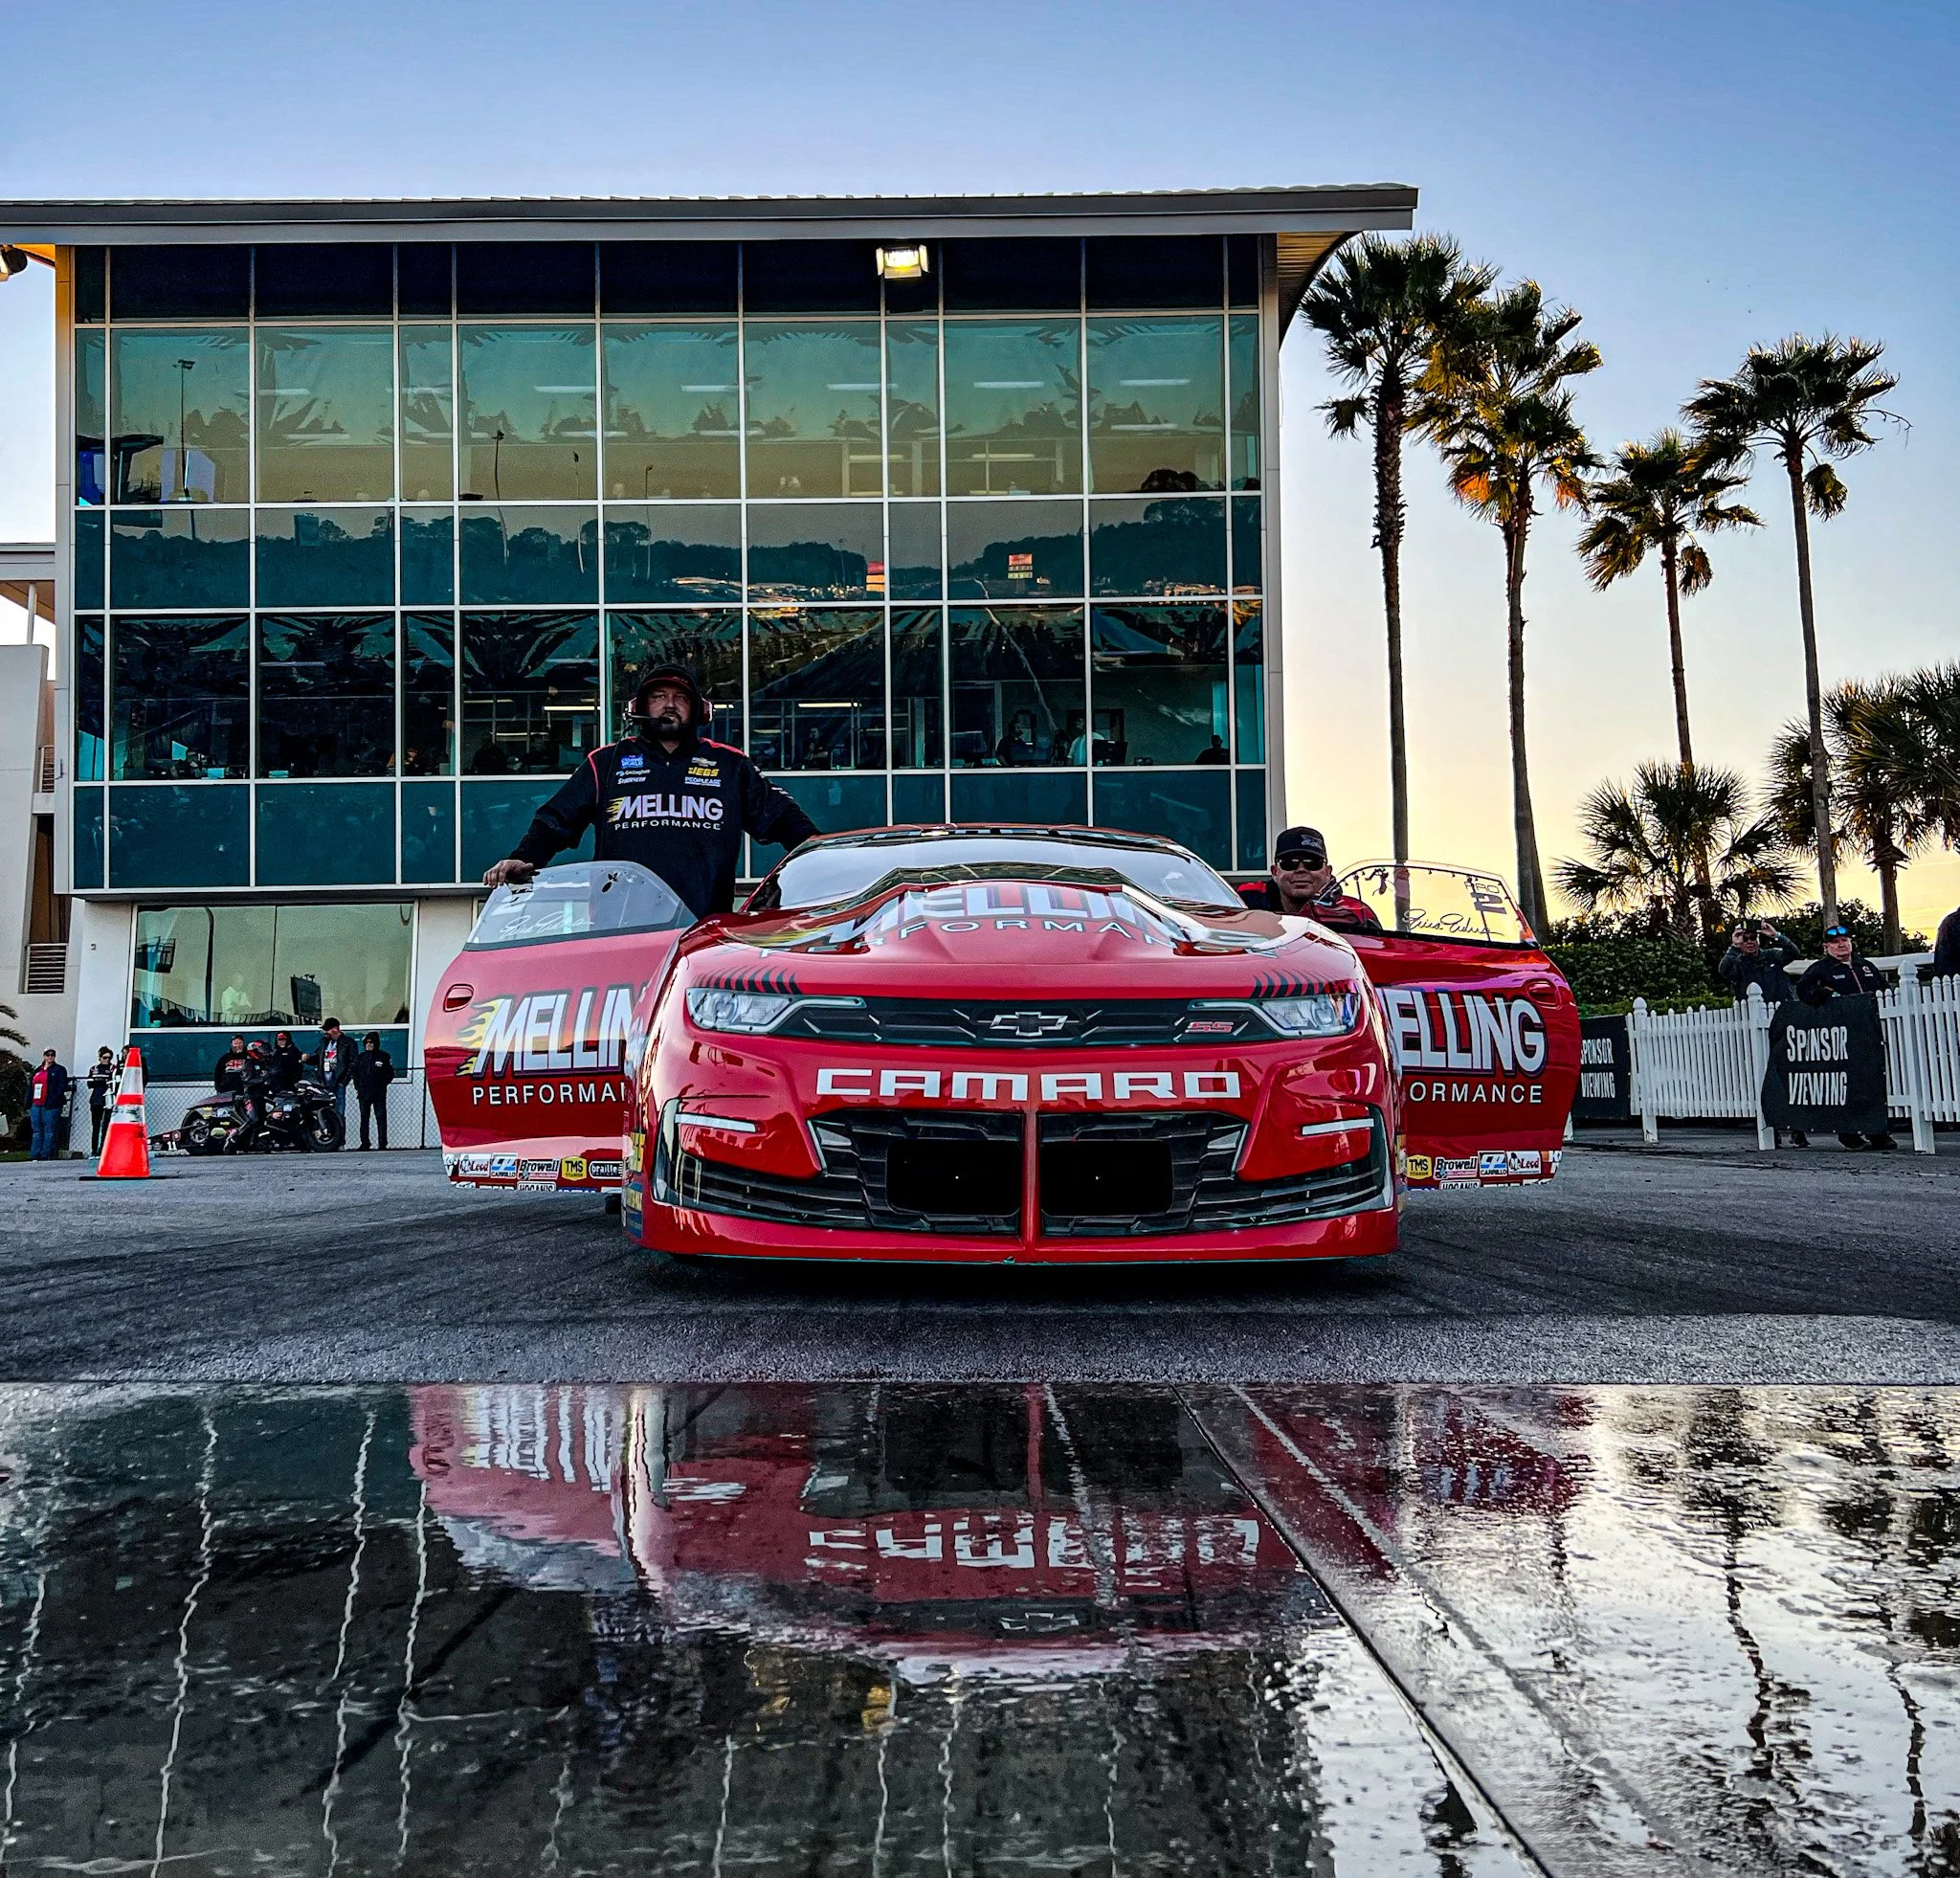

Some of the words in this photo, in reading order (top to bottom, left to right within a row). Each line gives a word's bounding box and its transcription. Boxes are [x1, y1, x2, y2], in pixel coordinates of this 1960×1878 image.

[688, 767, 720, 776] JEGS
[614, 794, 724, 821] MELLING
[614, 819, 722, 831] PERFORMANCE
[1470, 892, 1507, 915] 2
[1187, 1020, 1235, 1036] SS
[1786, 1024, 1849, 1062] SPONSOR
[815, 1068, 1241, 1102] CAMARO
[1580, 1072, 1615, 1099] VIEWING
[1788, 1070, 1848, 1106] VIEWING
[167, 1140, 178, 1151] 11
[520, 1159, 559, 1172] Browell
[565, 1160, 584, 1173] TMS
[591, 1164, 617, 1174] braille
[1408, 1158, 1429, 1171] TMS
[1437, 1157, 1478, 1171] Browell
